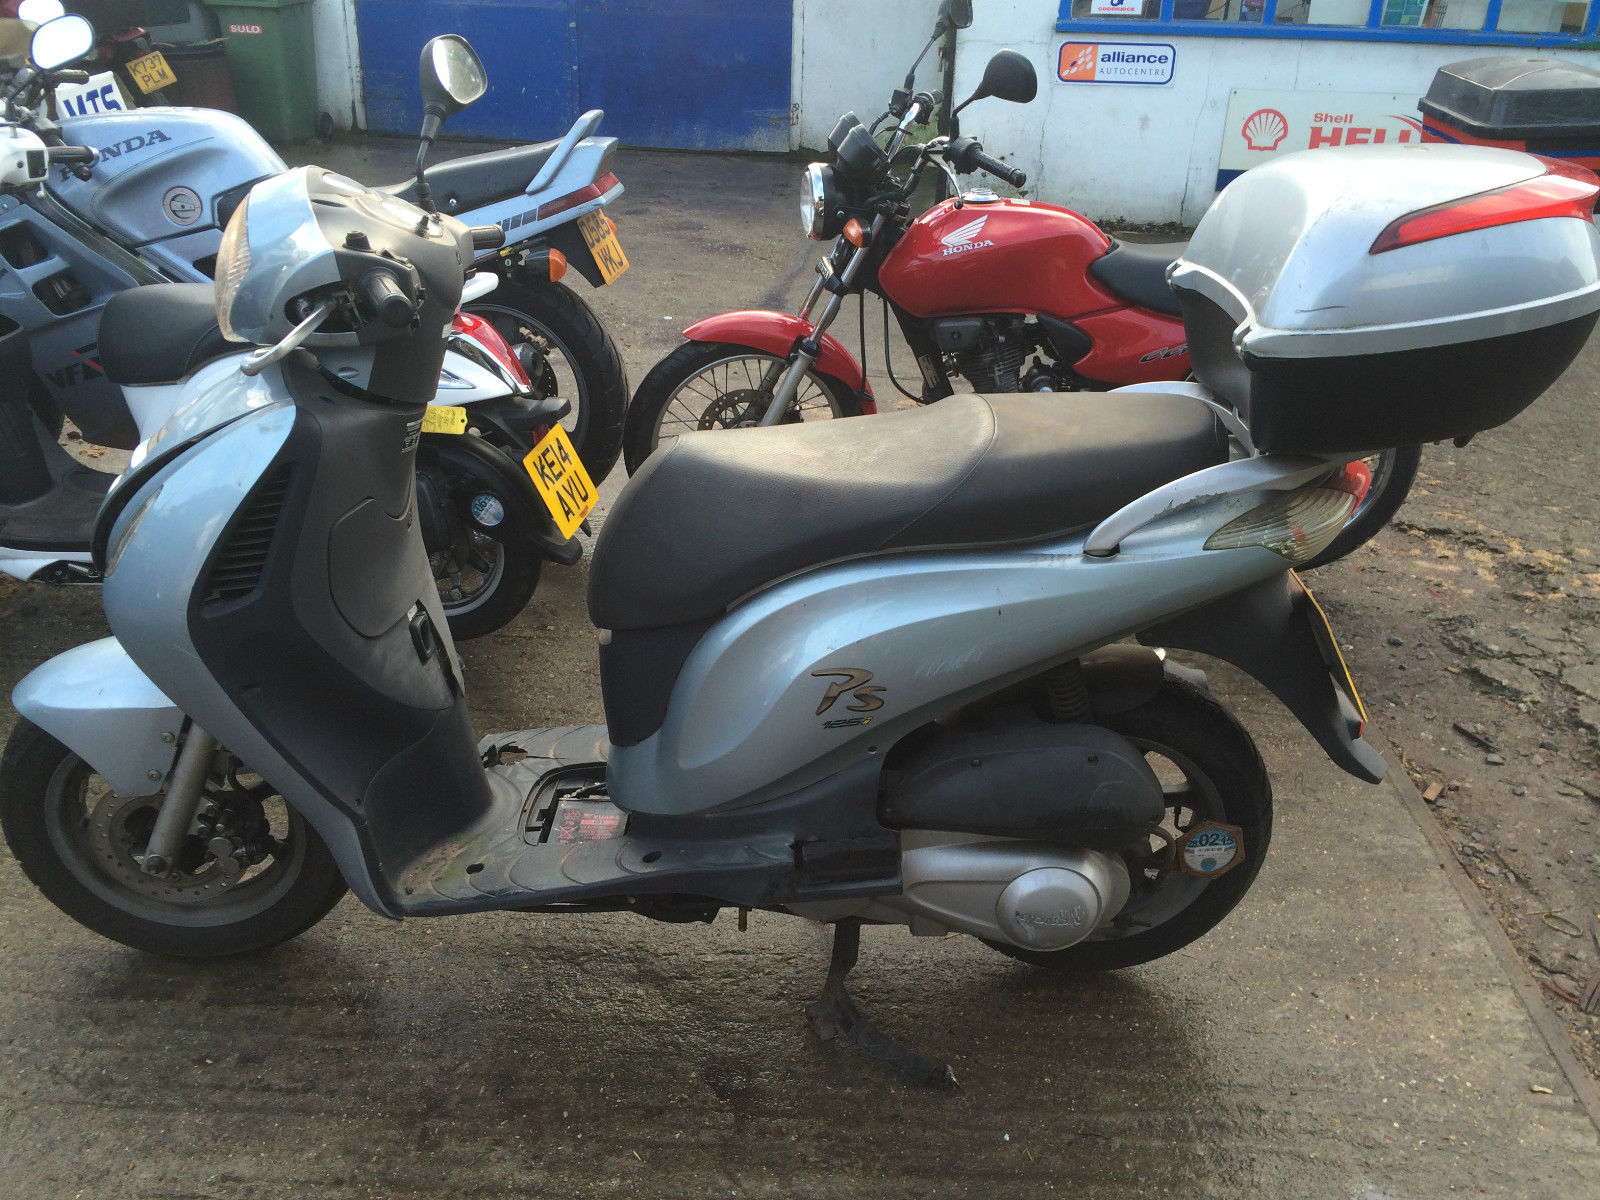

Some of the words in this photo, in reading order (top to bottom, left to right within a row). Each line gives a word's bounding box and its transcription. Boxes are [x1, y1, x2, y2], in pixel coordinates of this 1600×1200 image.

[231, 24, 260, 33] SULO
[1100, 51, 1169, 64] alliance
[128, 54, 162, 77] K737
[1099, 67, 1166, 76] AUTOCENTRE
[142, 68, 168, 87] PLM
[1313, 112, 1354, 124] Shell
[943, 240, 994, 256] HONDA
[533, 437, 573, 490] KE14
[555, 470, 589, 522] AYU
[1199, 833, 1219, 846] 02
